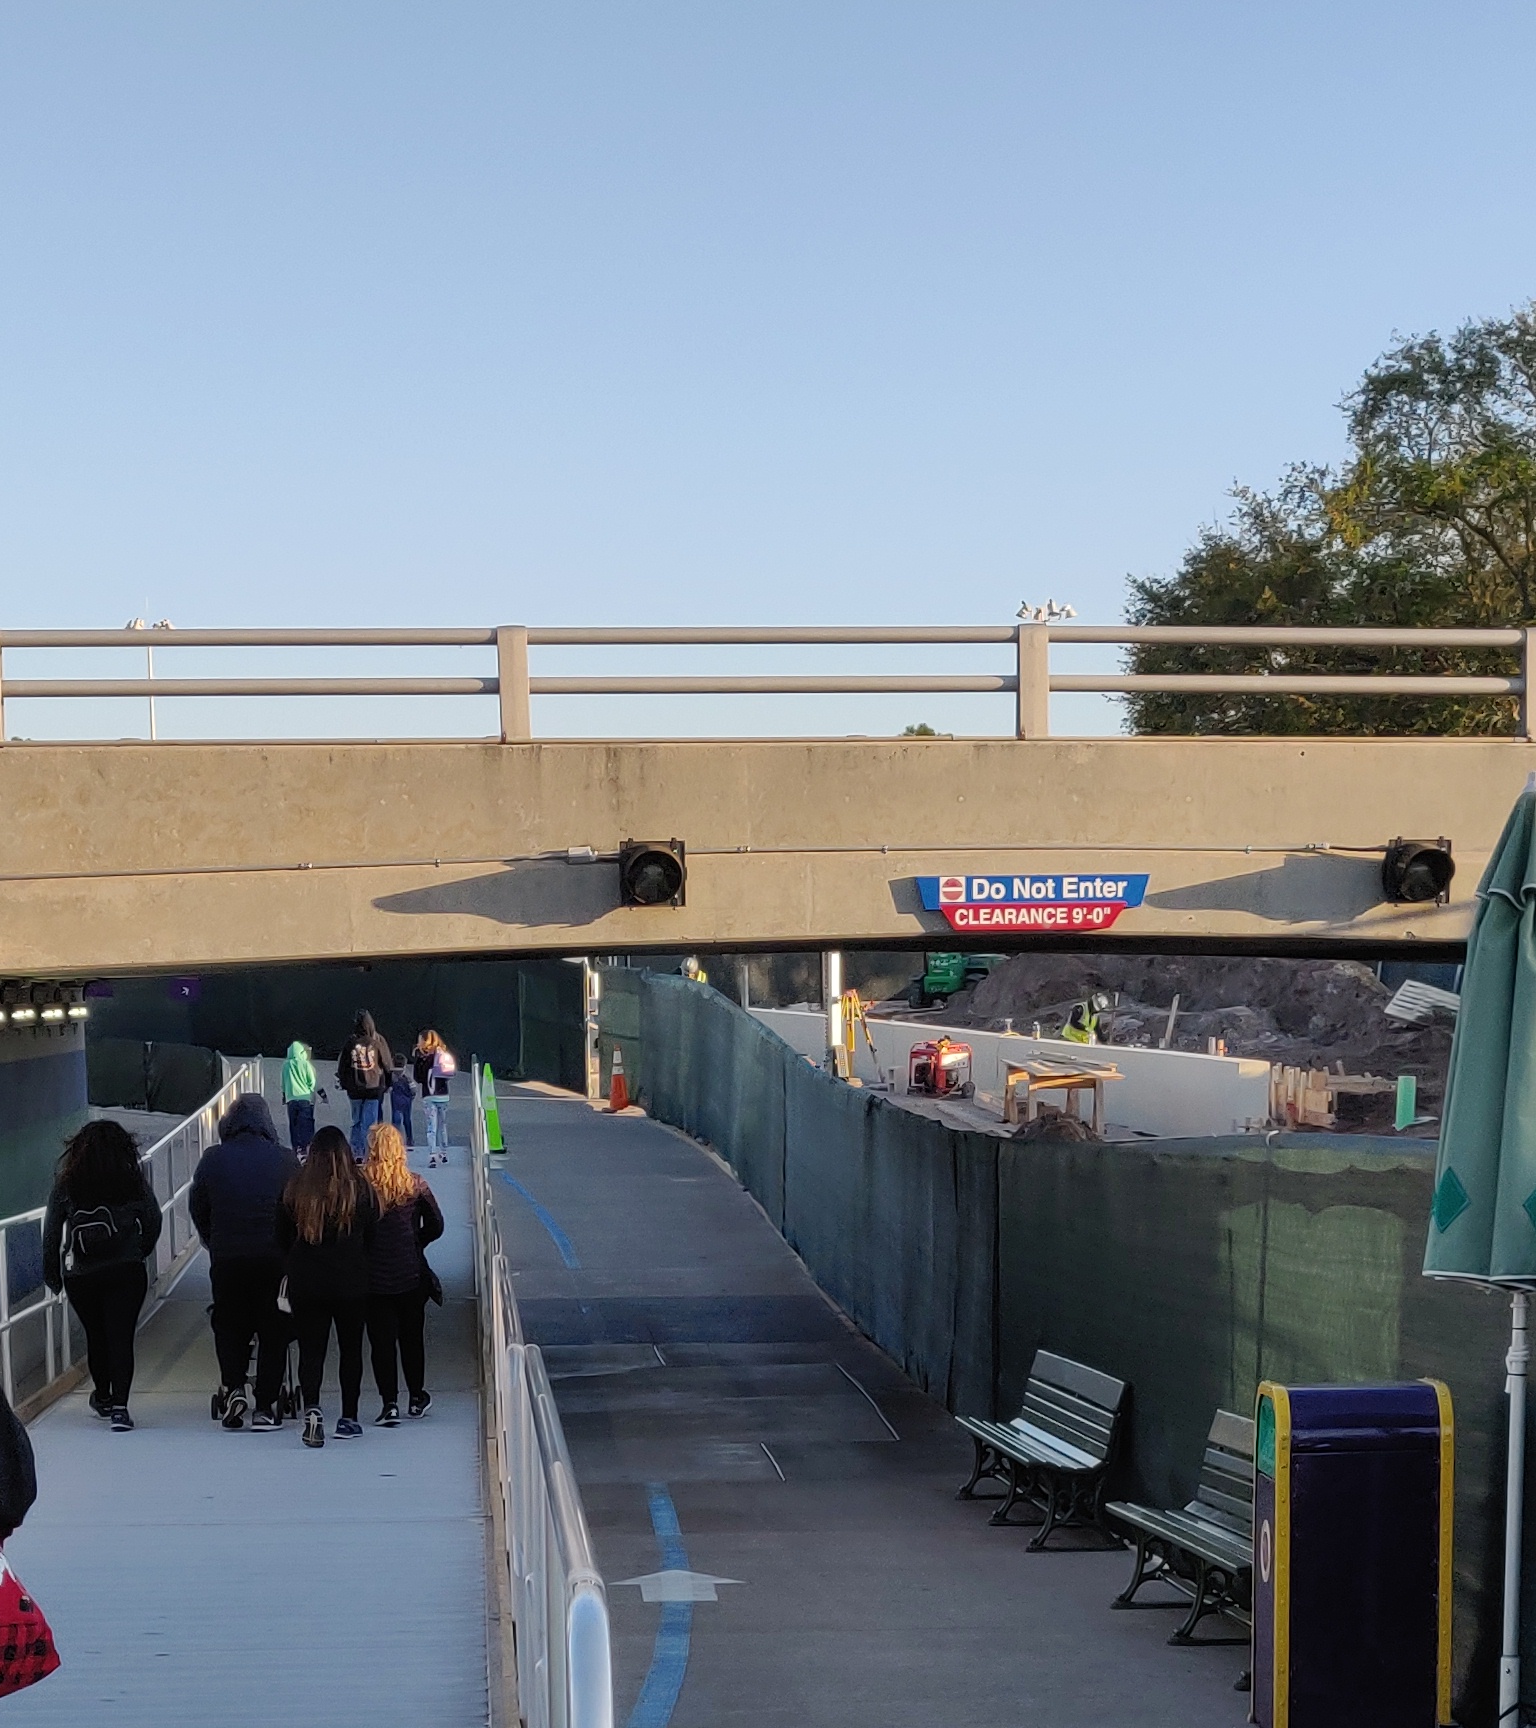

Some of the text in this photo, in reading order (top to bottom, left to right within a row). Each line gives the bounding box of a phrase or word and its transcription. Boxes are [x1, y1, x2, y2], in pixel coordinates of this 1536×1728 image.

[972, 878, 1128, 900] Do Not Enter
[955, 906, 1111, 925] CLEARANCE 9'-0"
